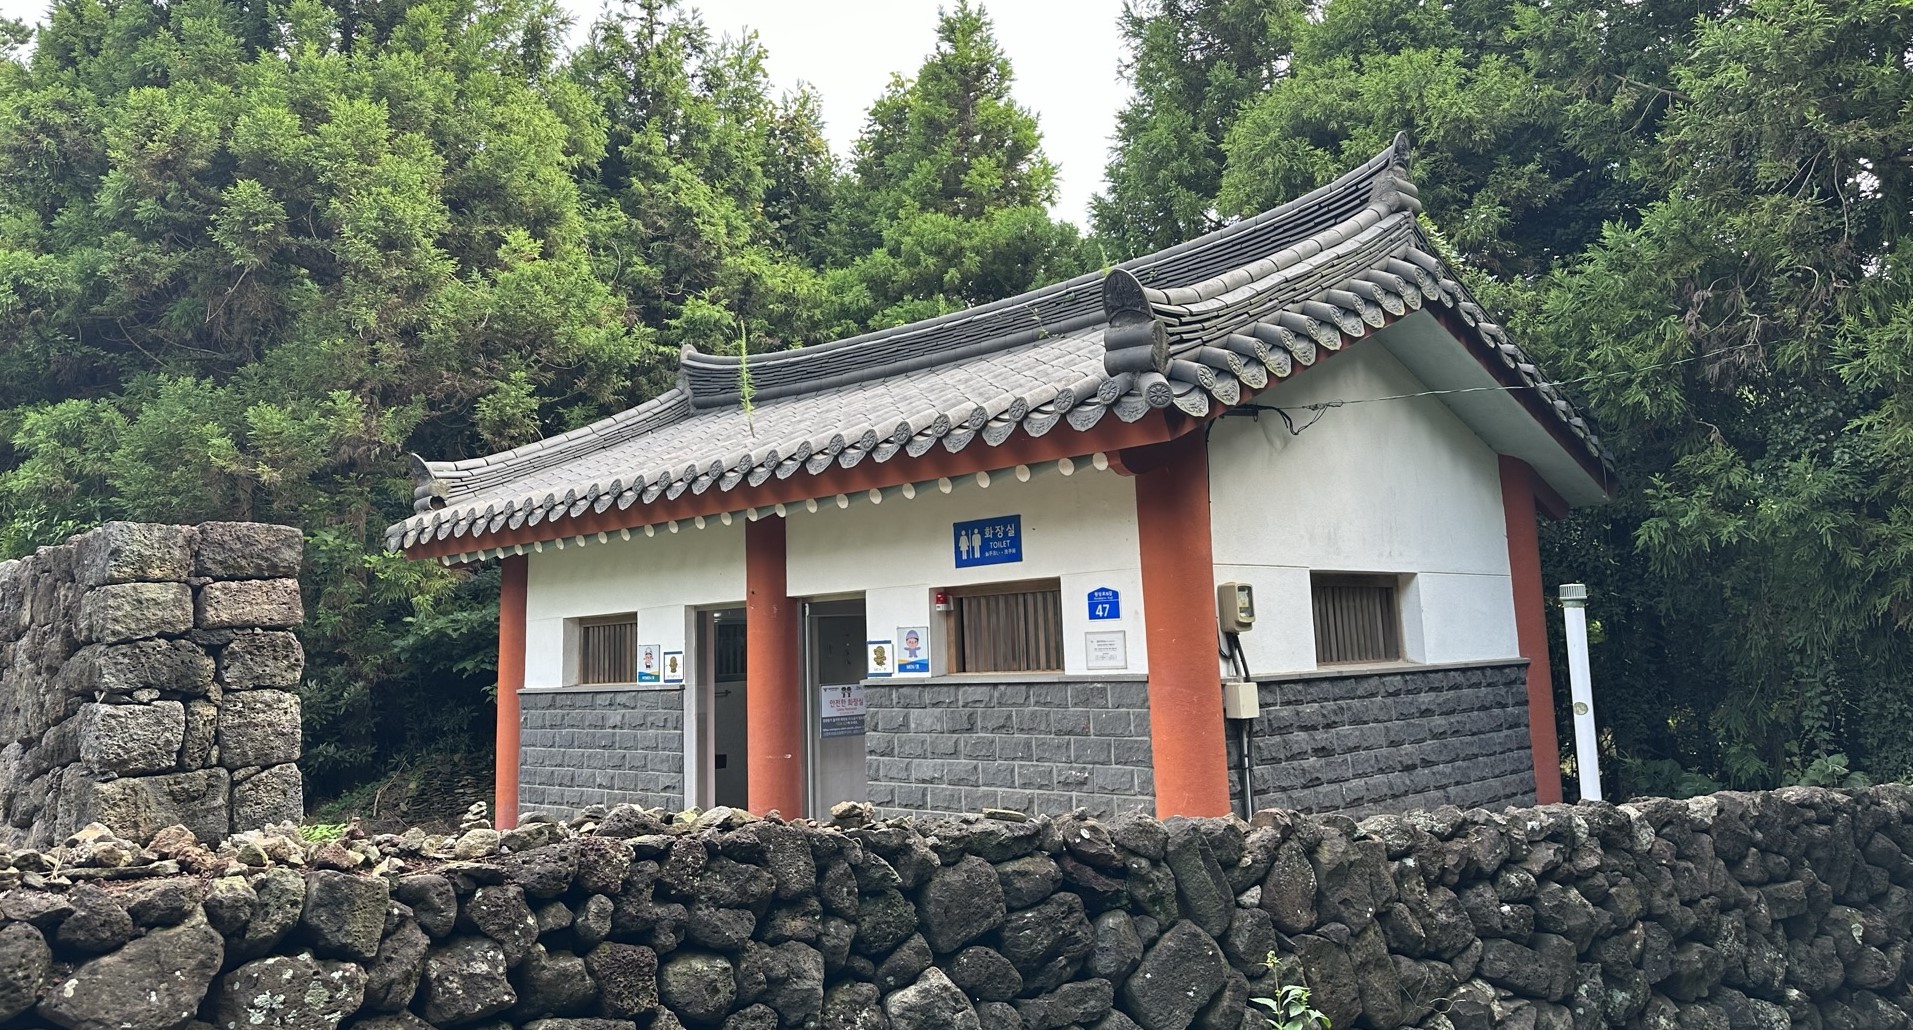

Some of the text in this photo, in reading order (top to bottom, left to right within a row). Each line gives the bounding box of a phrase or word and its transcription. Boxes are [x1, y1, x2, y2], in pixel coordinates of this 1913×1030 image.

[984, 523, 1015, 538] 화장실
[990, 540, 1010, 549] TOILET
[1095, 604, 1110, 617] 47
[829, 698, 864, 708] 안전한 화장실
